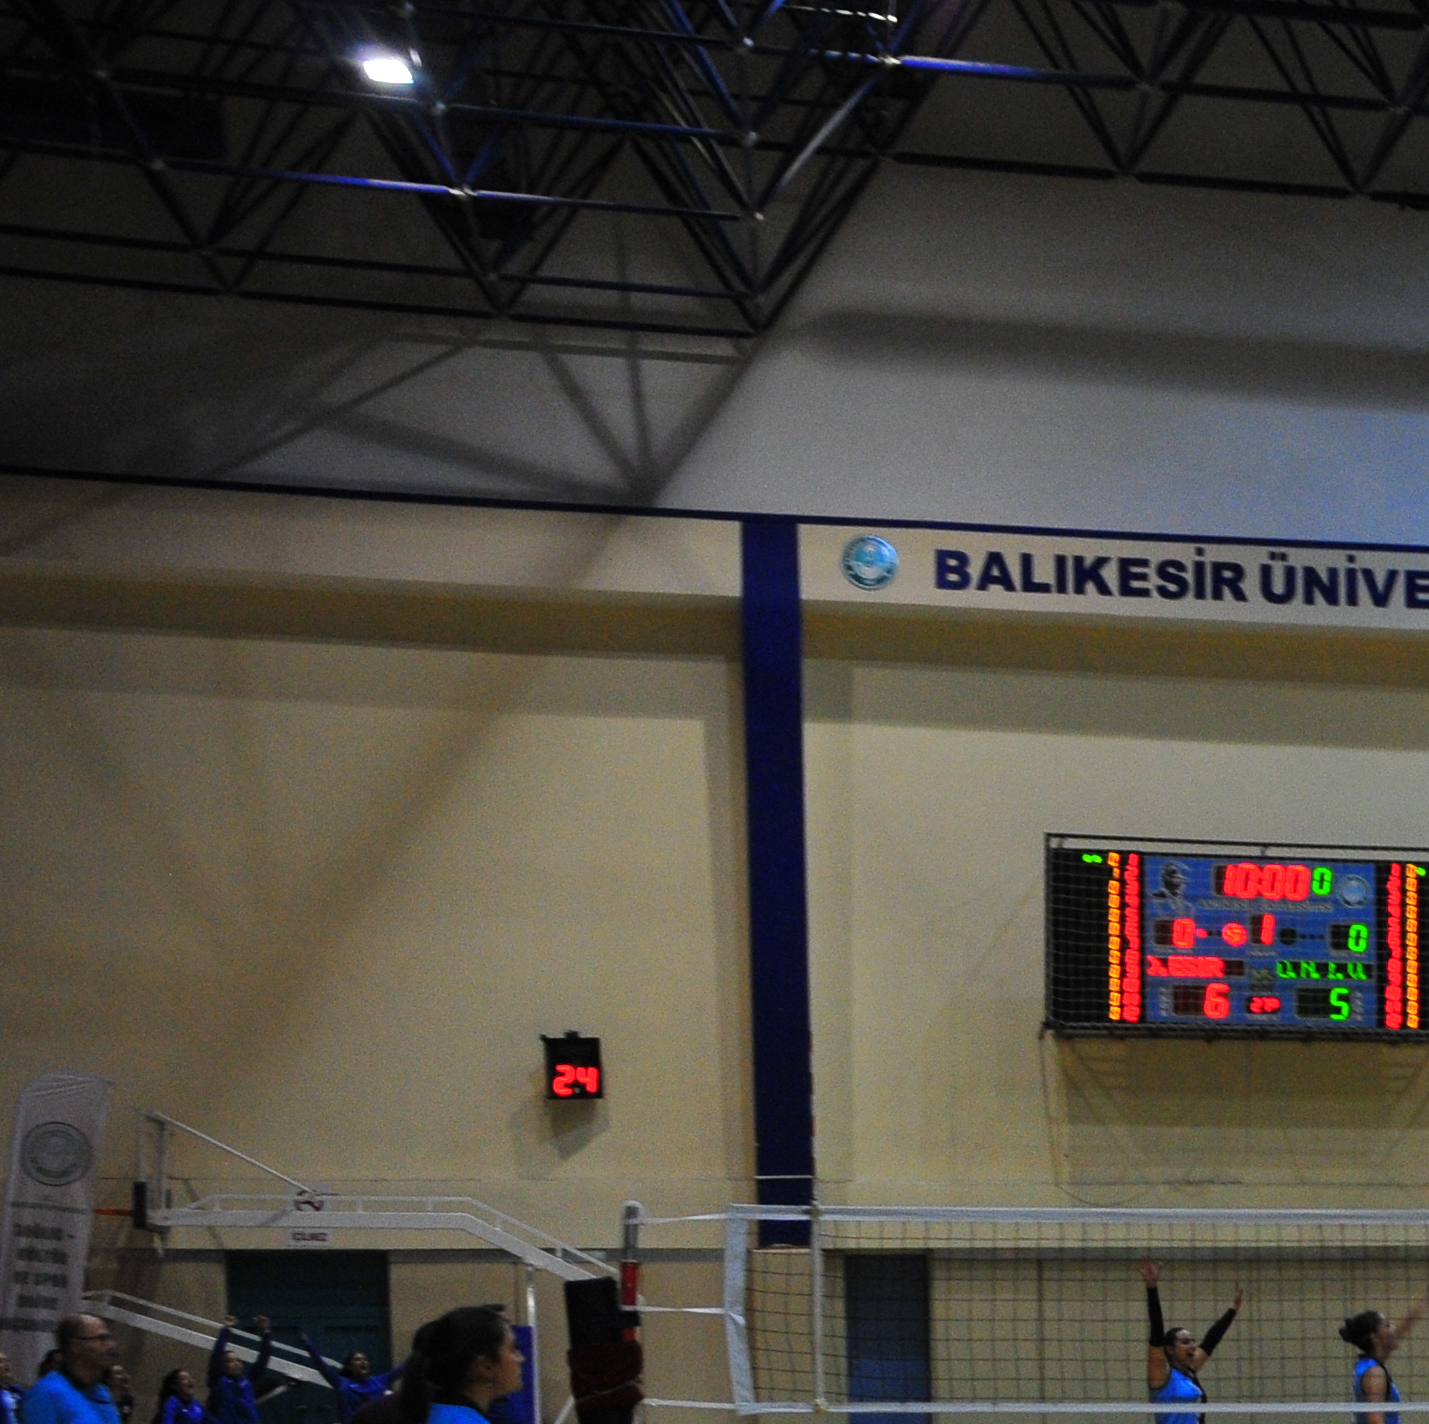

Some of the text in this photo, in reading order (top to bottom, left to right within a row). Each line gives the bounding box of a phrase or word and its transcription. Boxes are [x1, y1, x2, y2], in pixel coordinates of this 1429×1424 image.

[935, 547, 1248, 602] BALIKESİR
[1203, 982, 1231, 1020] 6
[1329, 986, 1351, 1021] 5
[552, 1063, 600, 1097] 24
